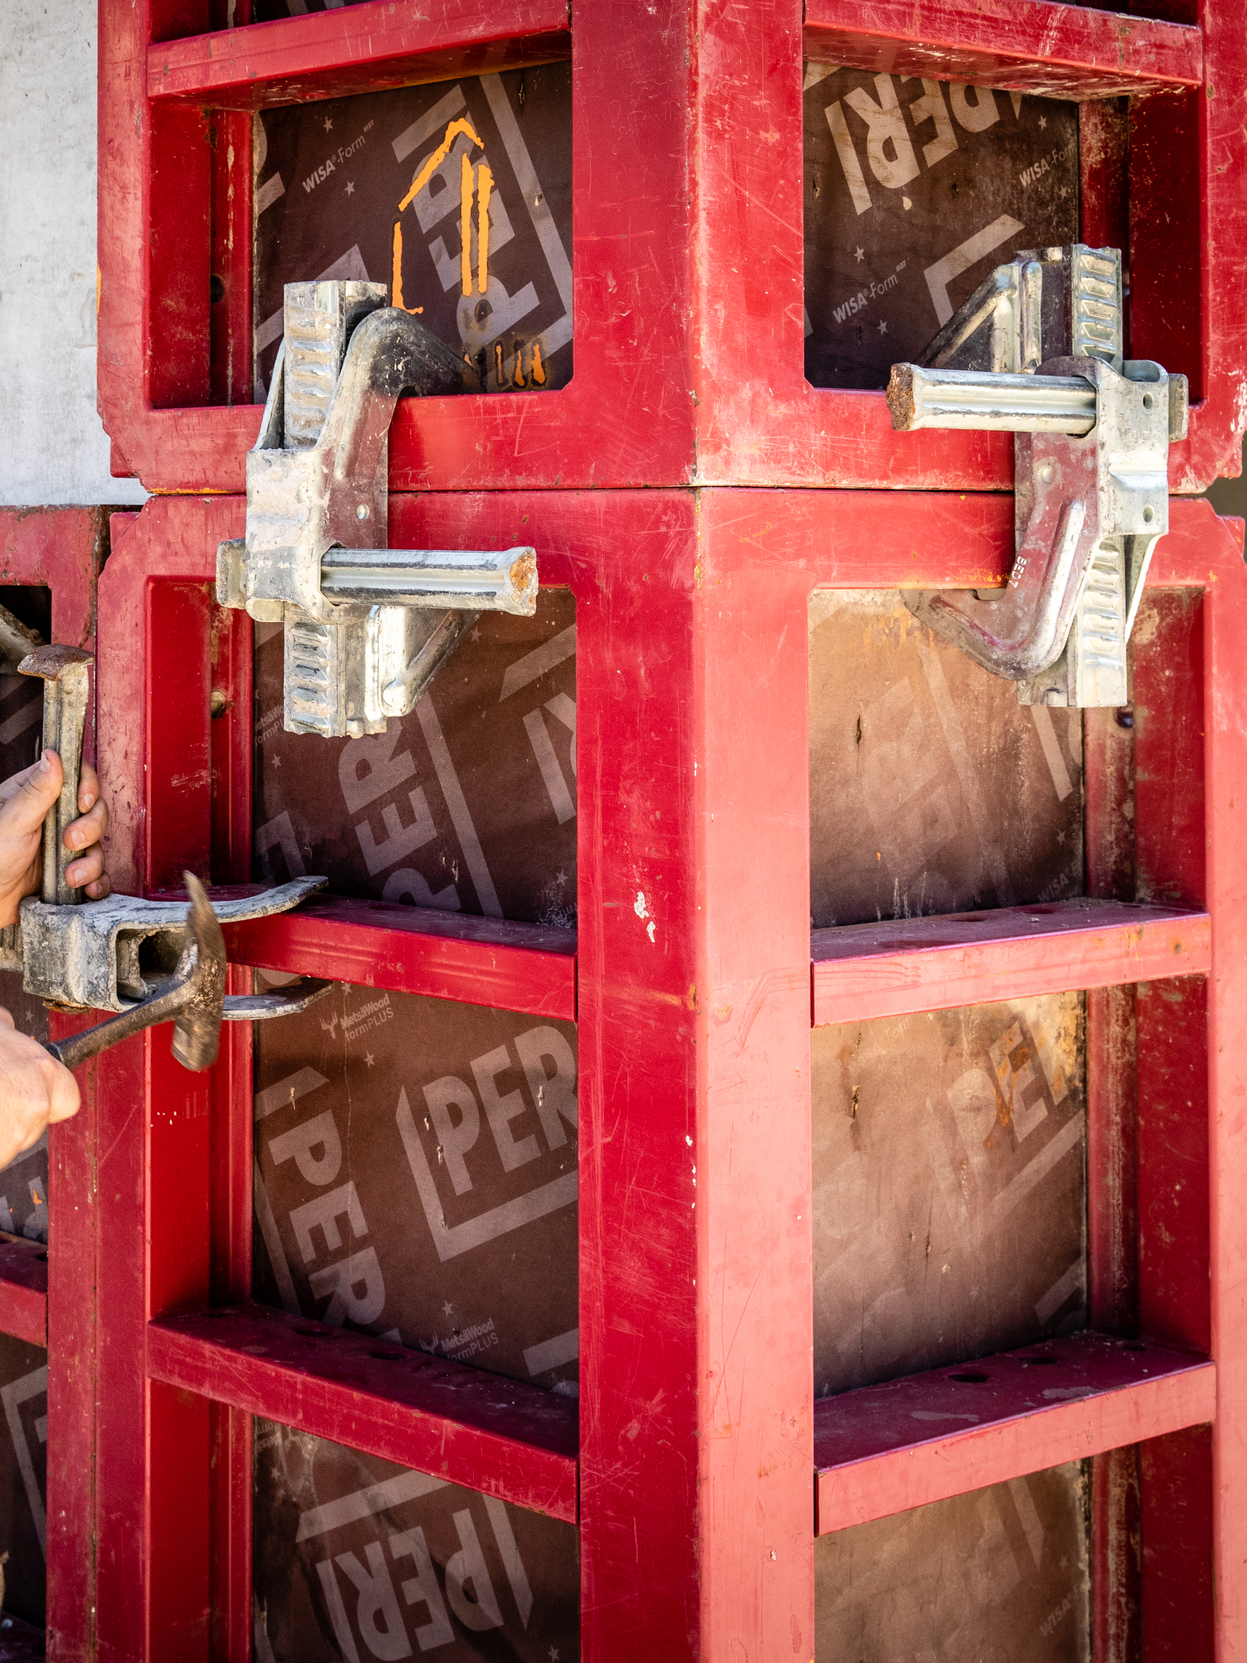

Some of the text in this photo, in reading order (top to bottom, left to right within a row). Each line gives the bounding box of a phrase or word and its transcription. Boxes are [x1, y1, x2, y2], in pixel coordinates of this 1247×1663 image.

[338, 715, 462, 911] PER
[345, 1007, 394, 1041] formPLUS
[422, 1025, 579, 1197] PER
[269, 1108, 402, 1346] PER
[316, 1508, 504, 1663] PERI
